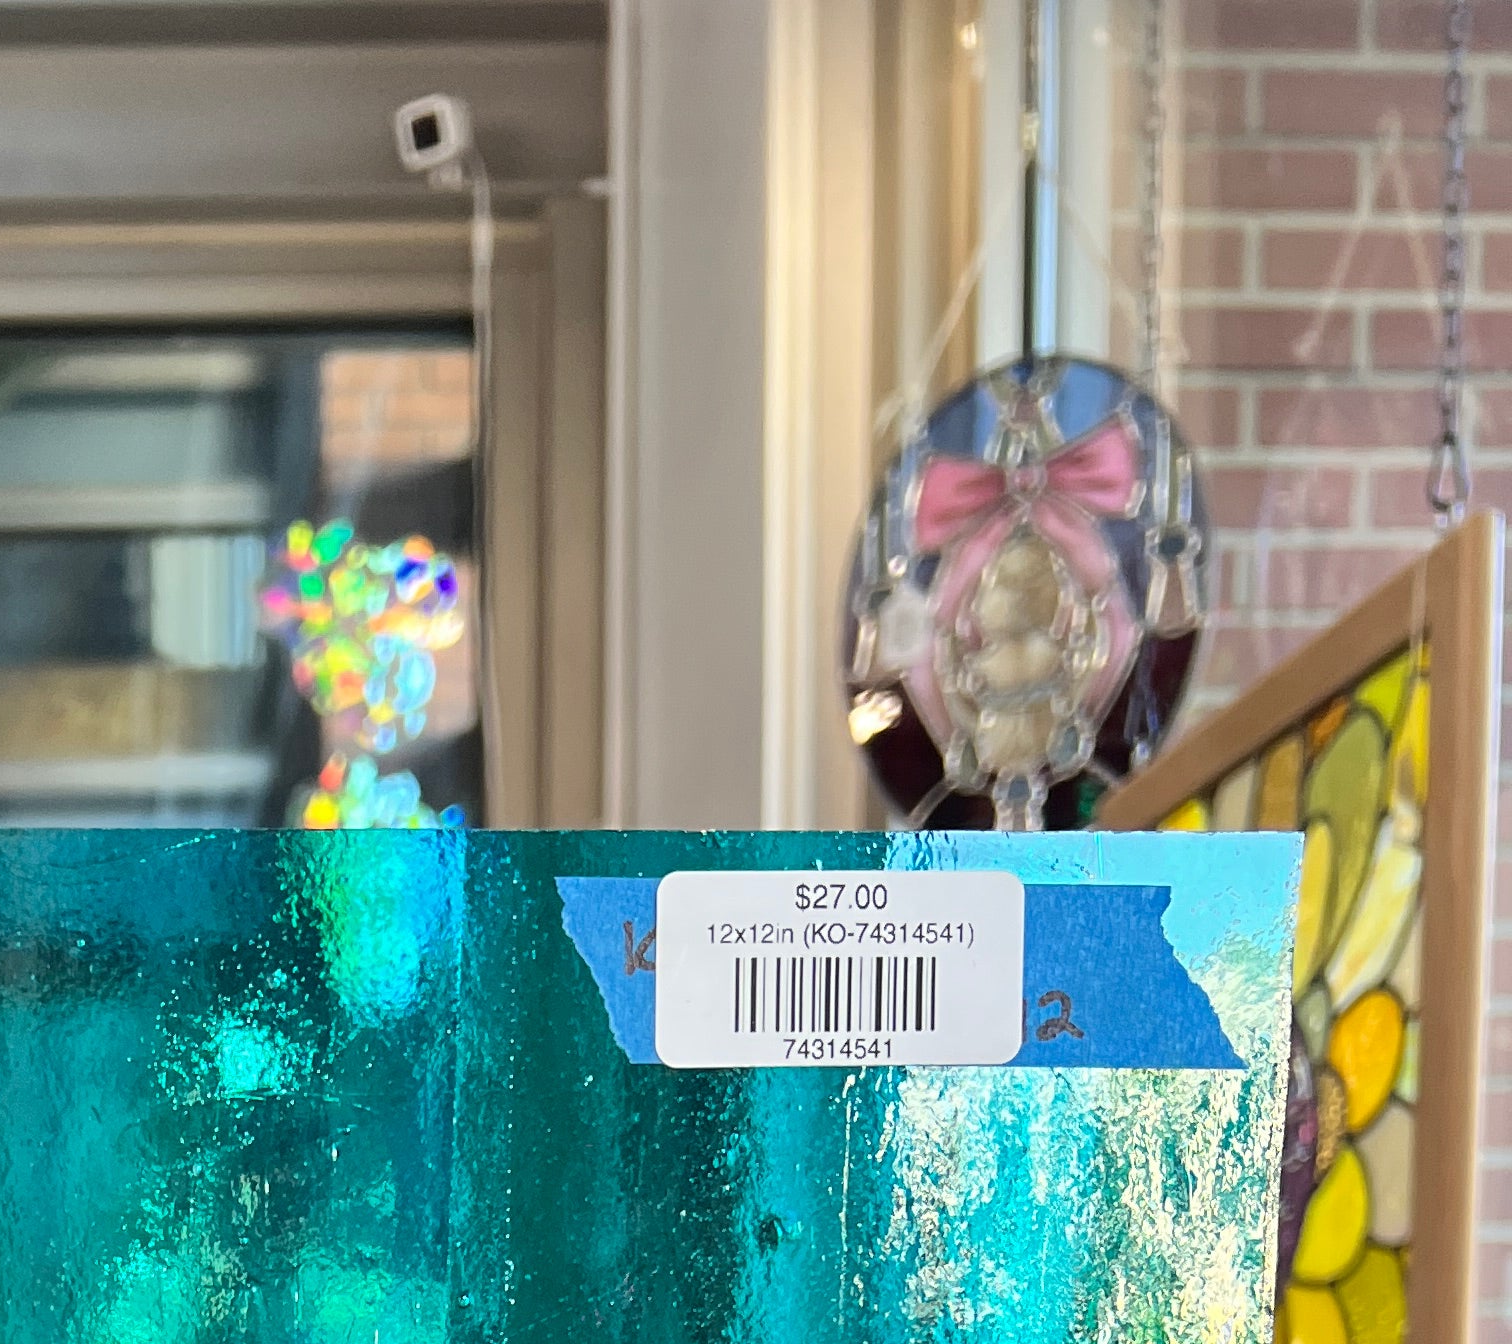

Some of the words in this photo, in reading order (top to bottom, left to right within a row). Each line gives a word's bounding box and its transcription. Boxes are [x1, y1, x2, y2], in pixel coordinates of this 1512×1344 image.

[794, 883, 888, 911] $27.00
[707, 922, 794, 945] 12x12in
[803, 922, 975, 949] (KO-74314541)
[782, 1038, 893, 1061] 74314541
